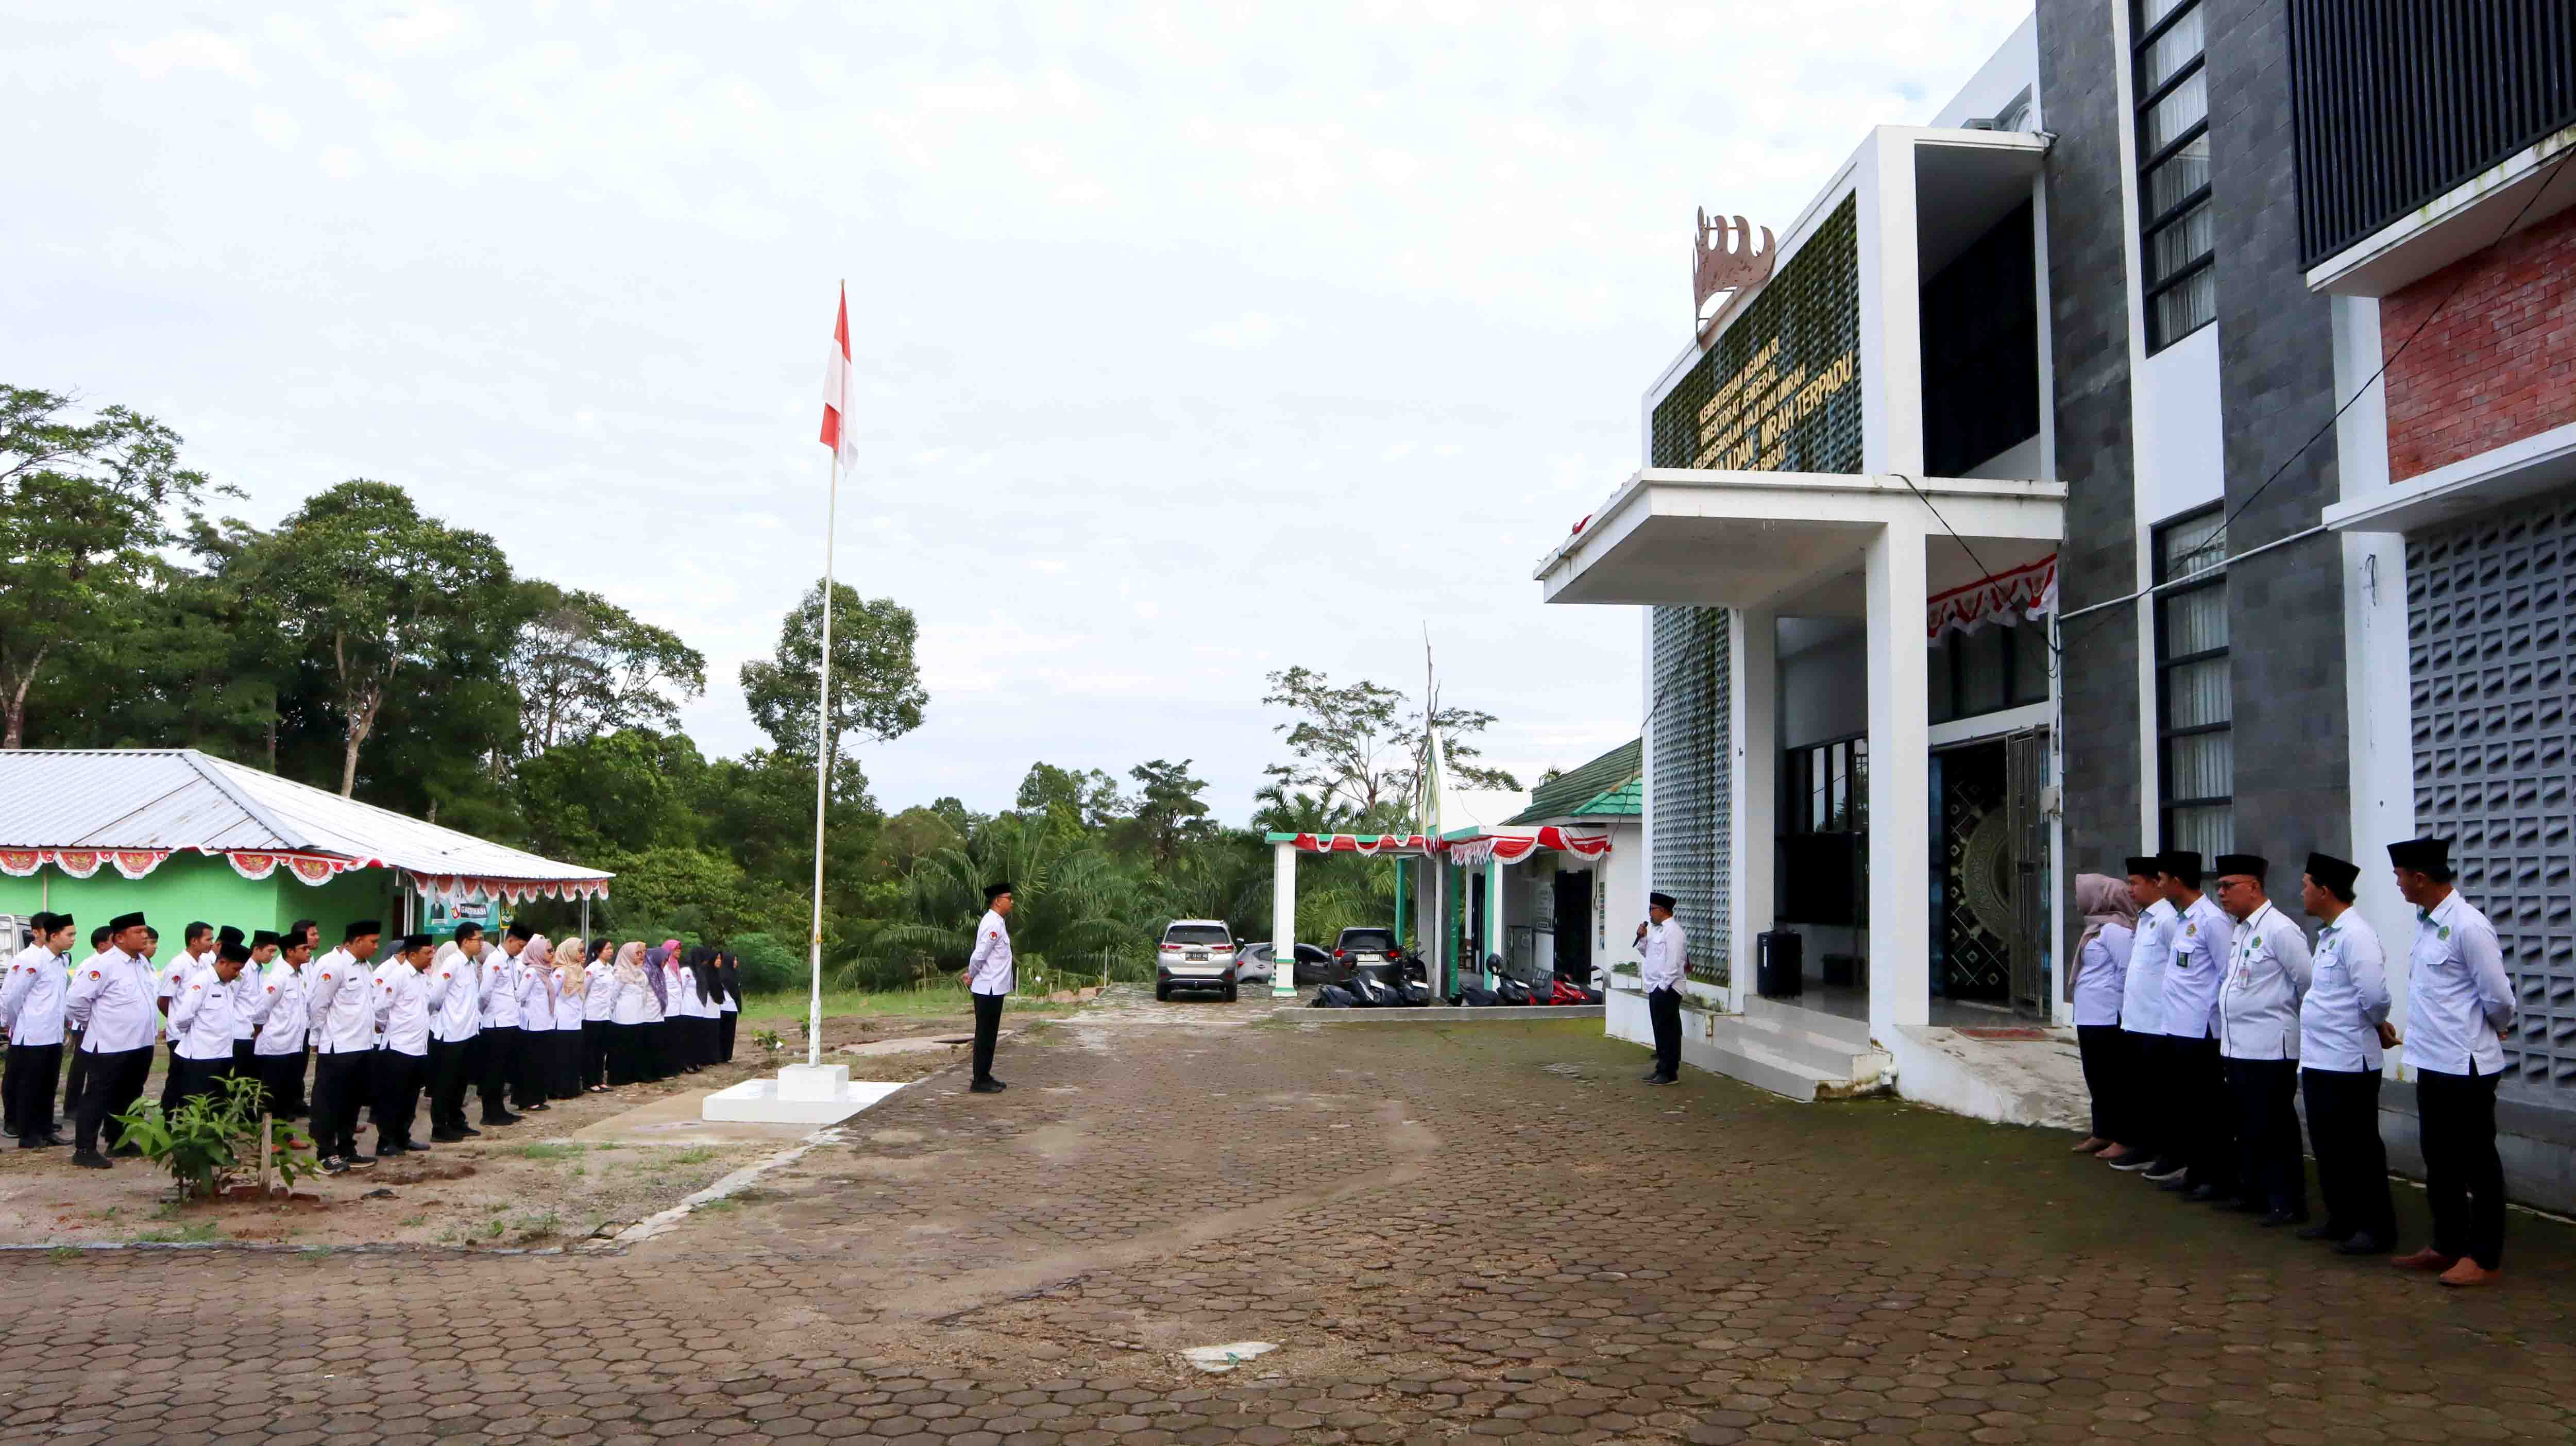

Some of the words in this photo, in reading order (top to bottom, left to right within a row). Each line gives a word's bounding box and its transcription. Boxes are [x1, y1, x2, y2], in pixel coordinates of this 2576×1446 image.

[1700, 371, 1742, 426] KEMENTERIAN
[1744, 346, 1770, 384] AGAMA
[1771, 336, 1780, 357] RI
[1701, 397, 1740, 447] DIREKTORAT
[1741, 364, 1777, 409] JENDERAL
[1733, 435, 1753, 470] DAN
[1795, 350, 1853, 420] TERPADU
[1744, 404, 1759, 433] HAJI
[1761, 390, 1776, 418] DAN
[1777, 362, 1805, 402] UMRAH
[1760, 441, 1786, 470] BARAT
